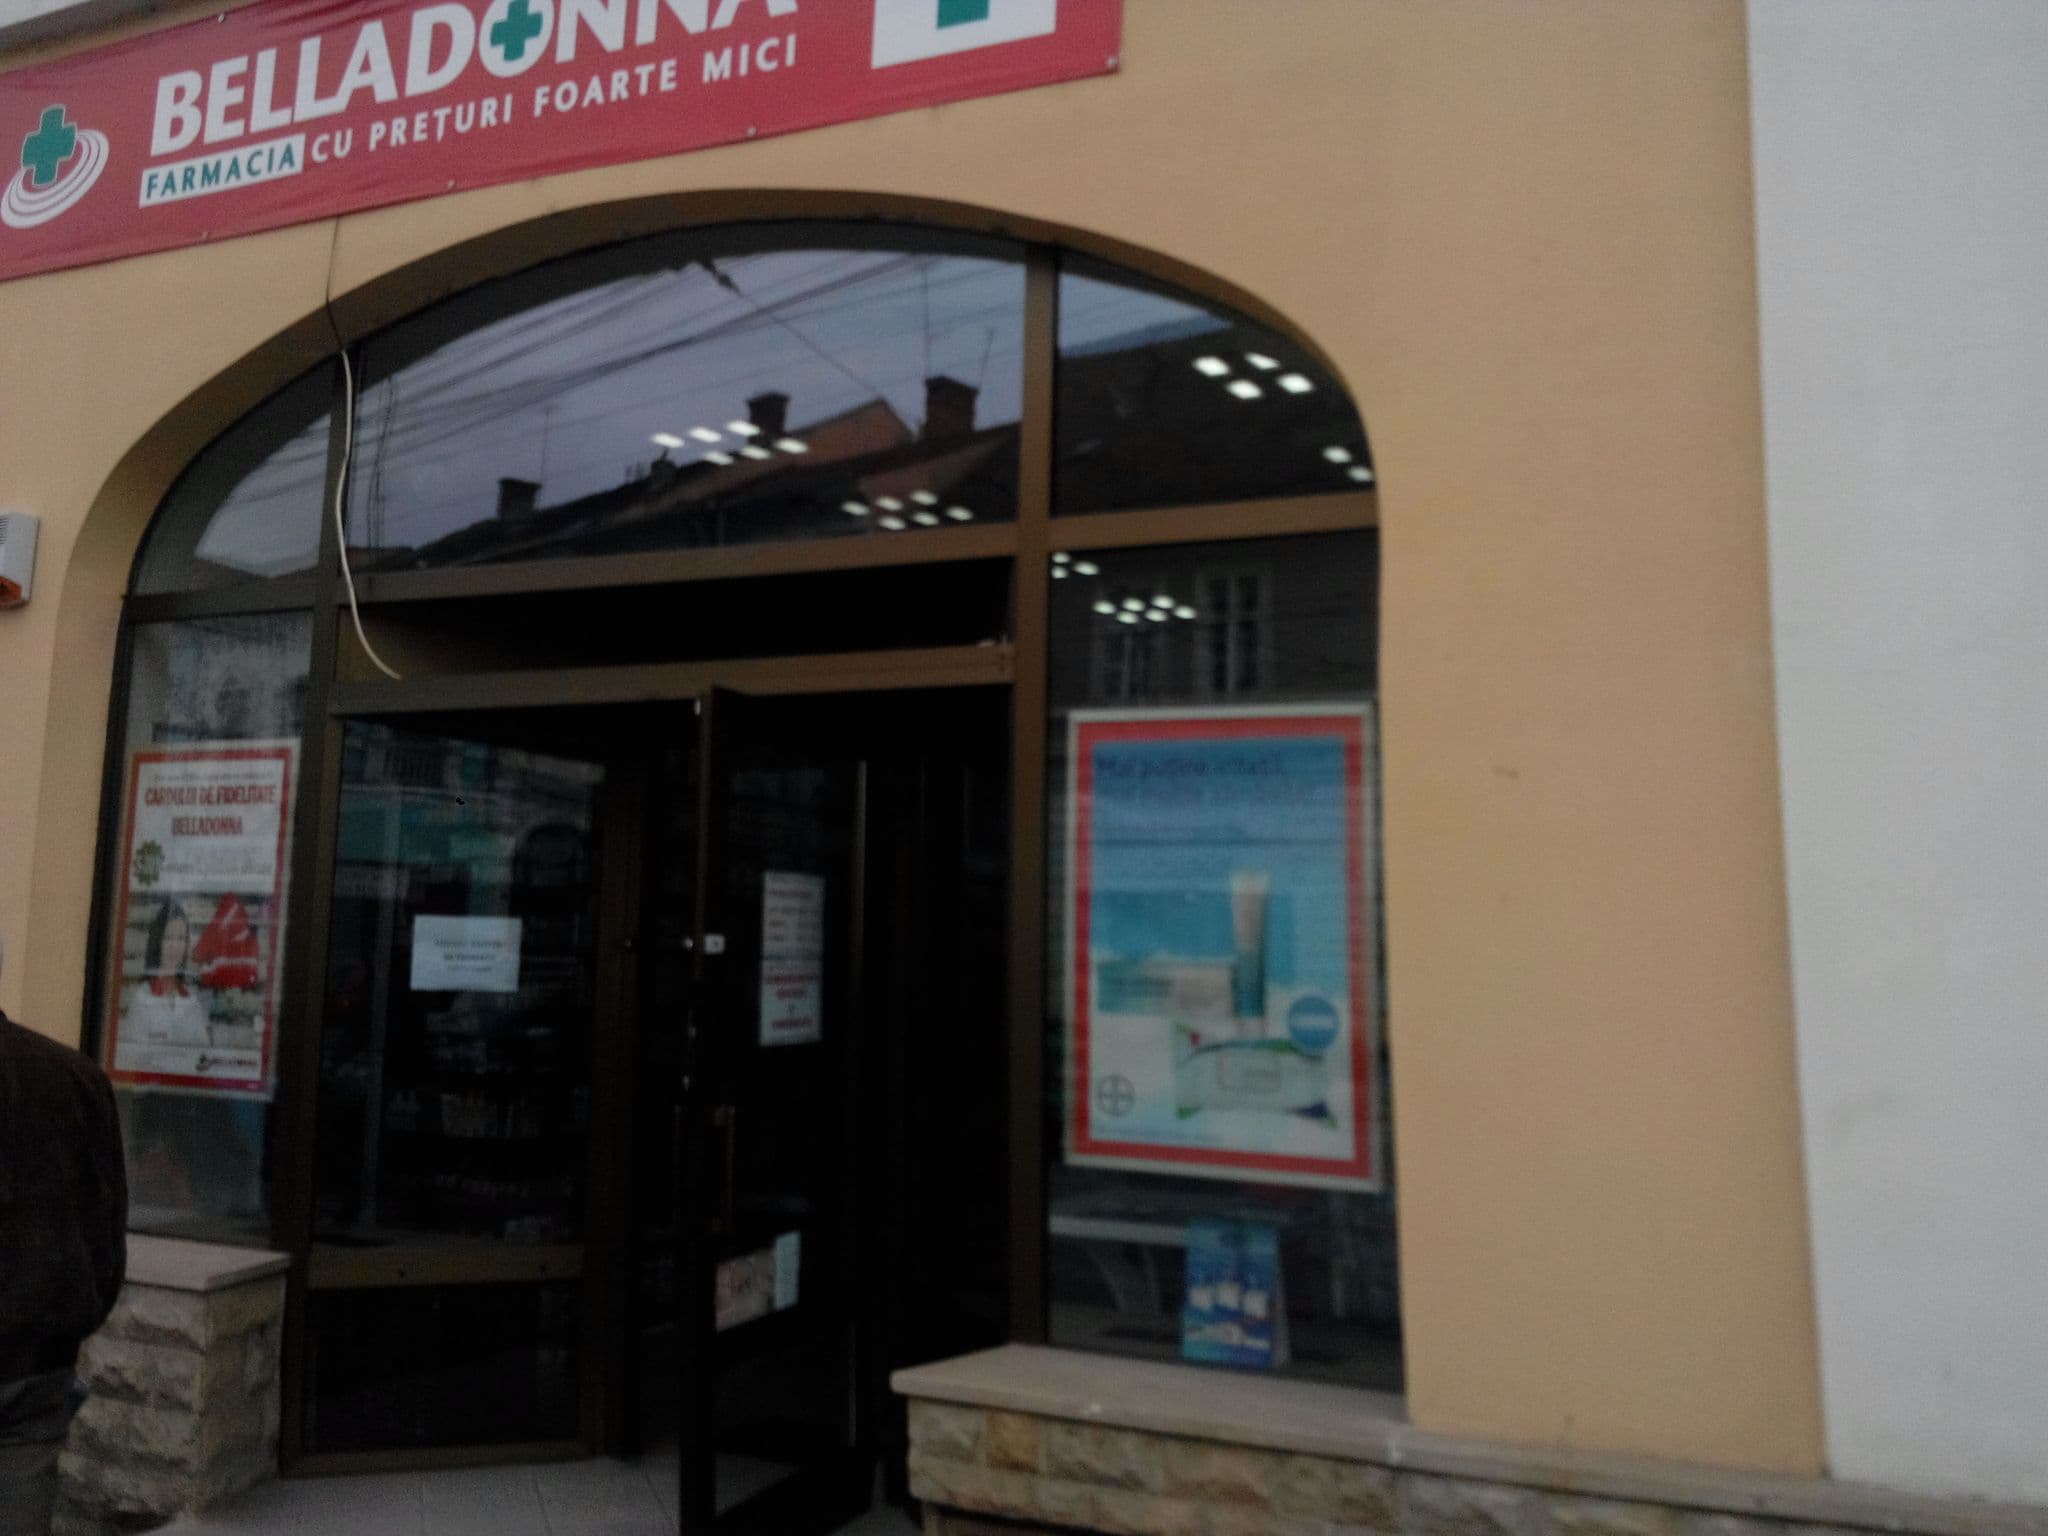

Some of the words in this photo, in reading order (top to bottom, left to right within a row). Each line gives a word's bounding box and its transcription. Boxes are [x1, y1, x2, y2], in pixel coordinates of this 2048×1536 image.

[146, 142, 296, 200] FARMACIA
[311, 130, 353, 164] CU
[533, 65, 678, 118] FOARTE
[702, 34, 797, 84] MICI
[150, 0, 798, 157] BELLADONN
[172, 816, 242, 836] BELLADONNA
[217, 784, 276, 804] FIDELITATE
